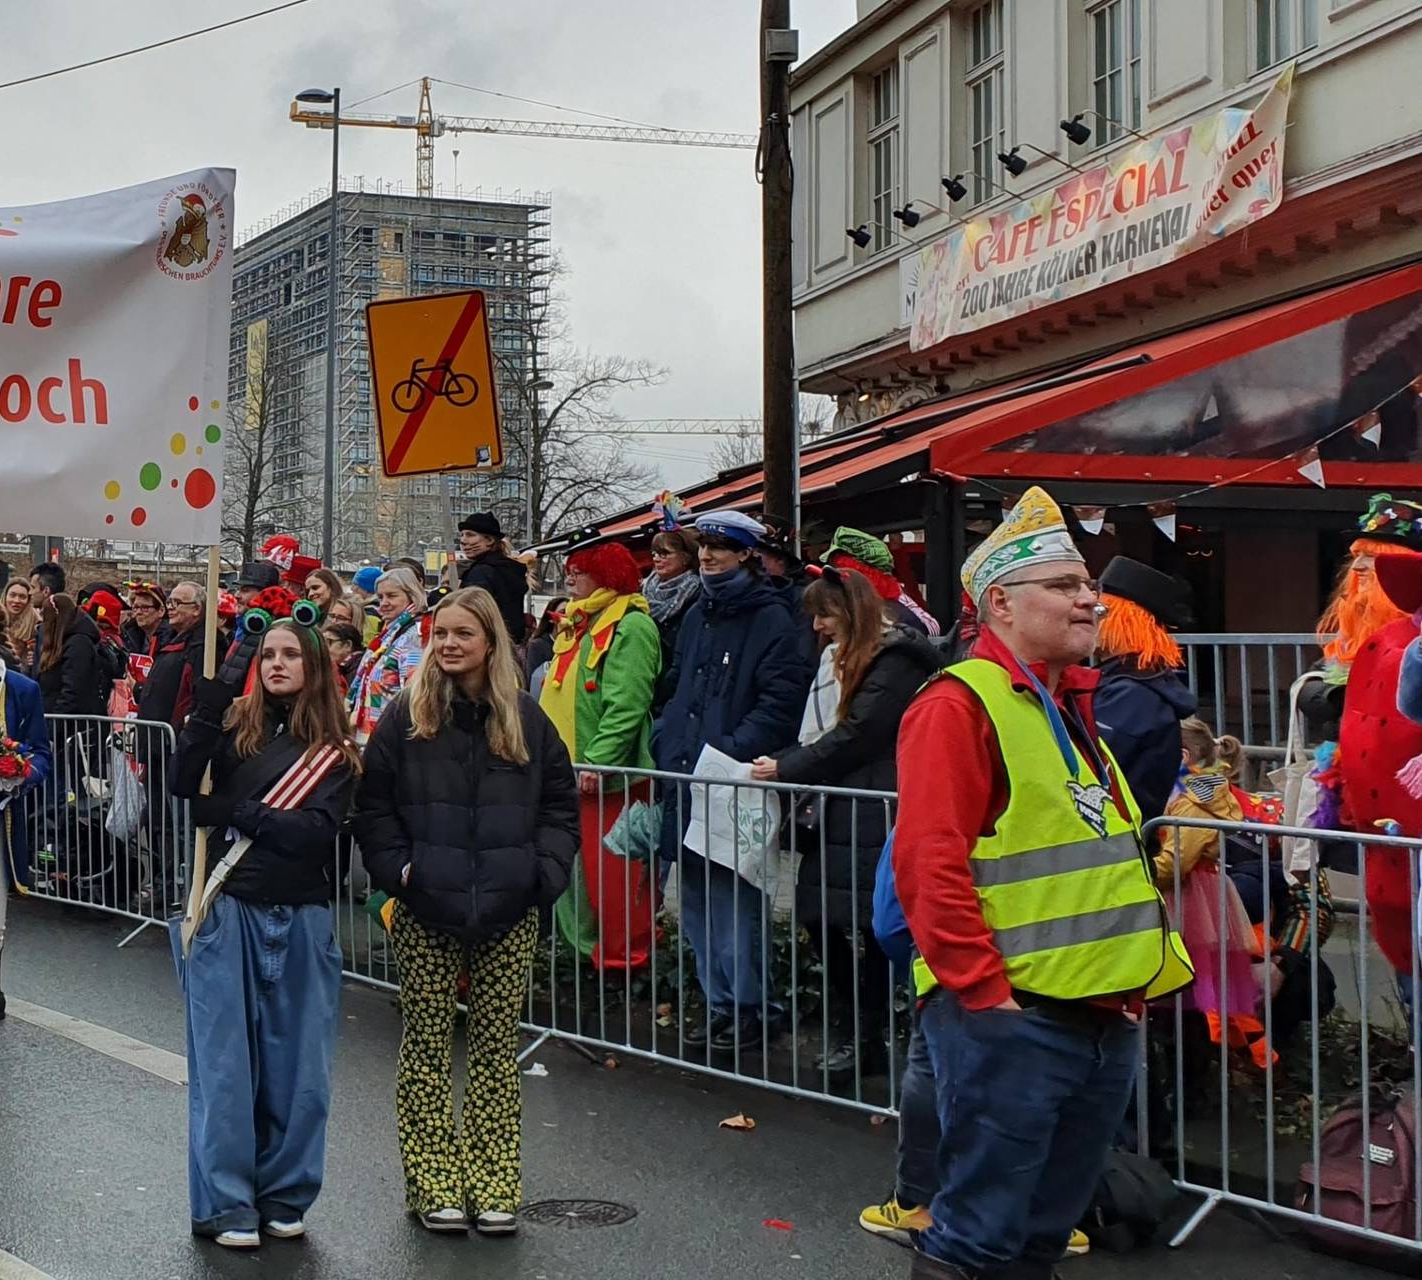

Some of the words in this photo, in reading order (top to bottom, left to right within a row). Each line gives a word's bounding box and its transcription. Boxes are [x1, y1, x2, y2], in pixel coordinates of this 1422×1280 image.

[1047, 148, 1190, 247] ESPECIAL
[1232, 137, 1278, 189] quer
[960, 277, 990, 319] 200
[989, 262, 1037, 309] JAHRE
[1035, 239, 1097, 293] KÖLNER
[1101, 202, 1193, 269] KARNEVAL
